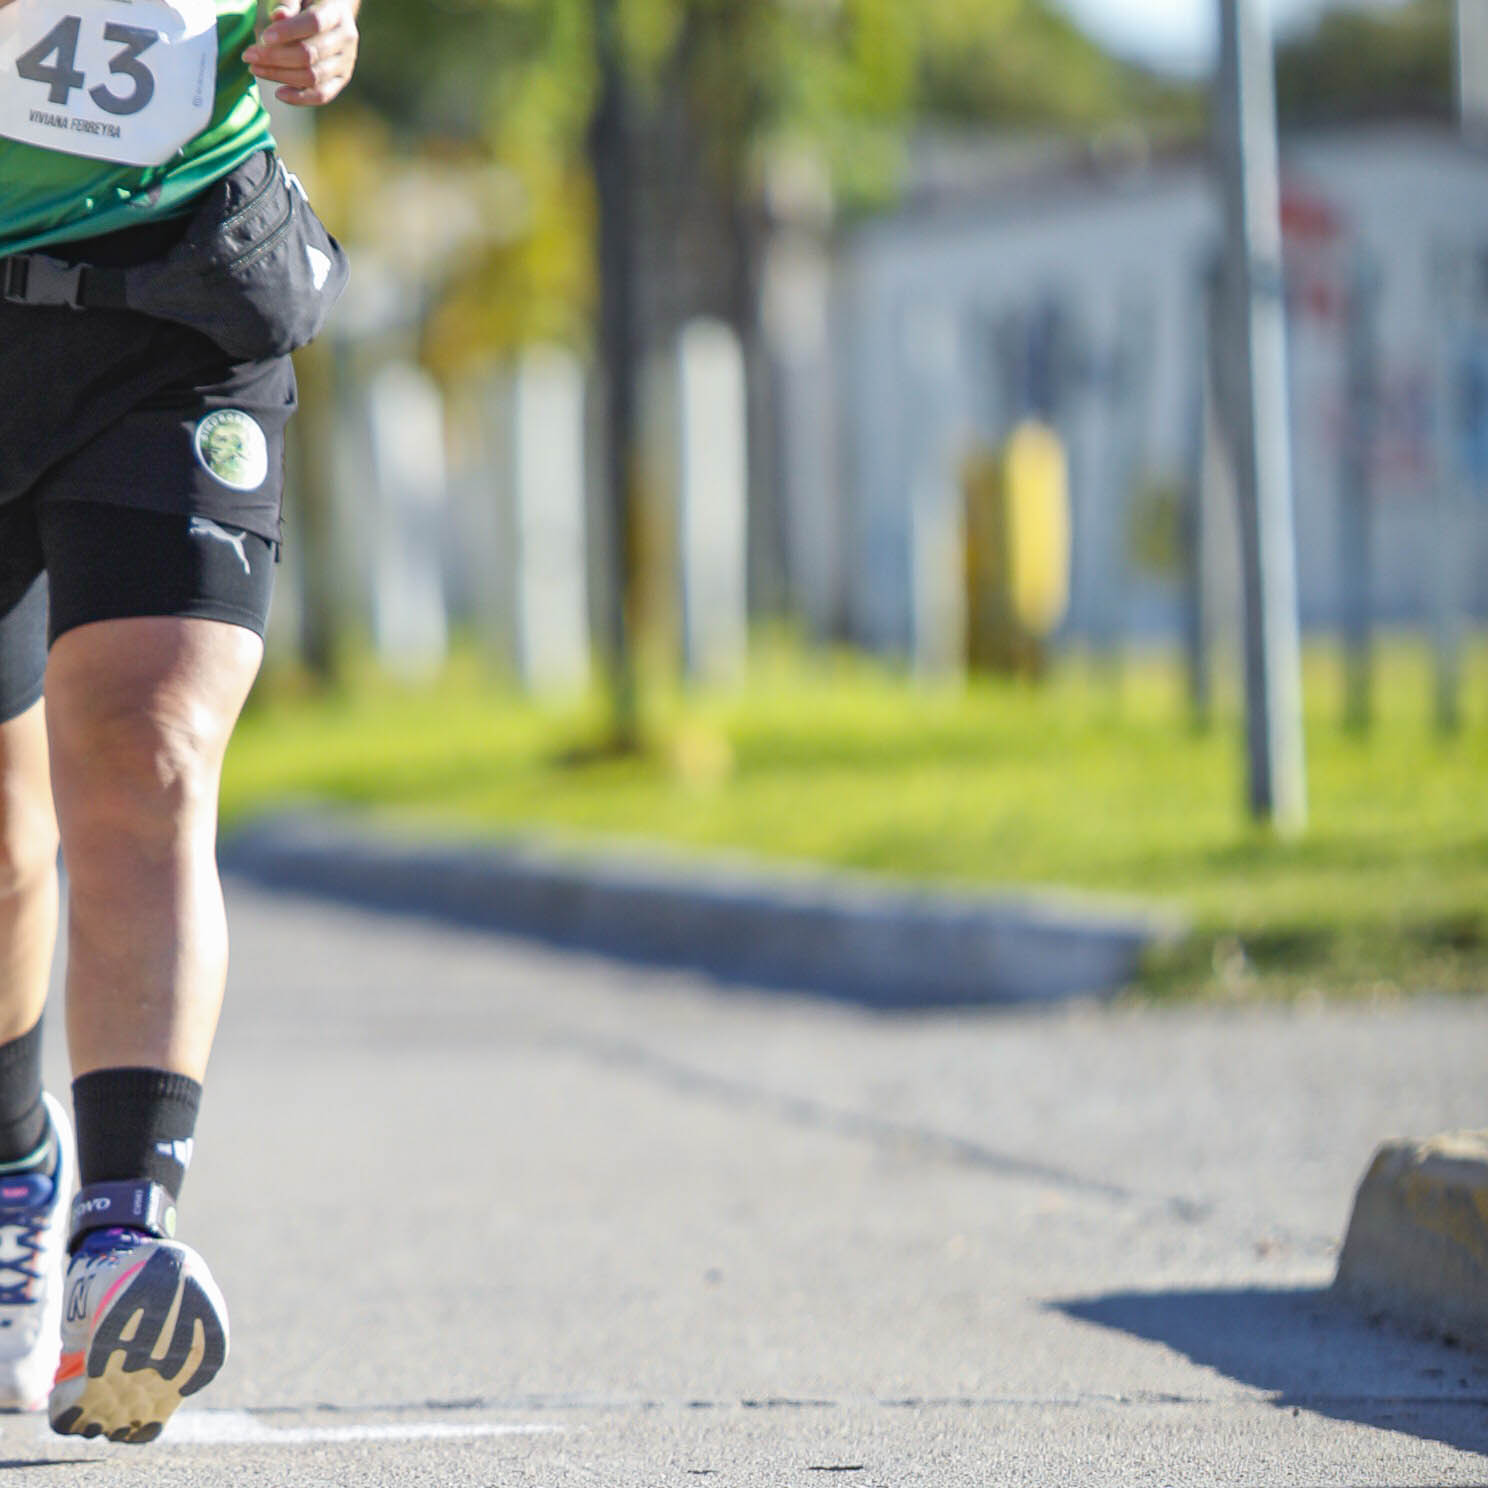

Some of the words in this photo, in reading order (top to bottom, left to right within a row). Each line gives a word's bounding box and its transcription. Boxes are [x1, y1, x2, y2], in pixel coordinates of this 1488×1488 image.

[16, 15, 158, 116] 43
[29, 109, 69, 129] VIVIANA
[71, 118, 121, 139] FERREYRA
